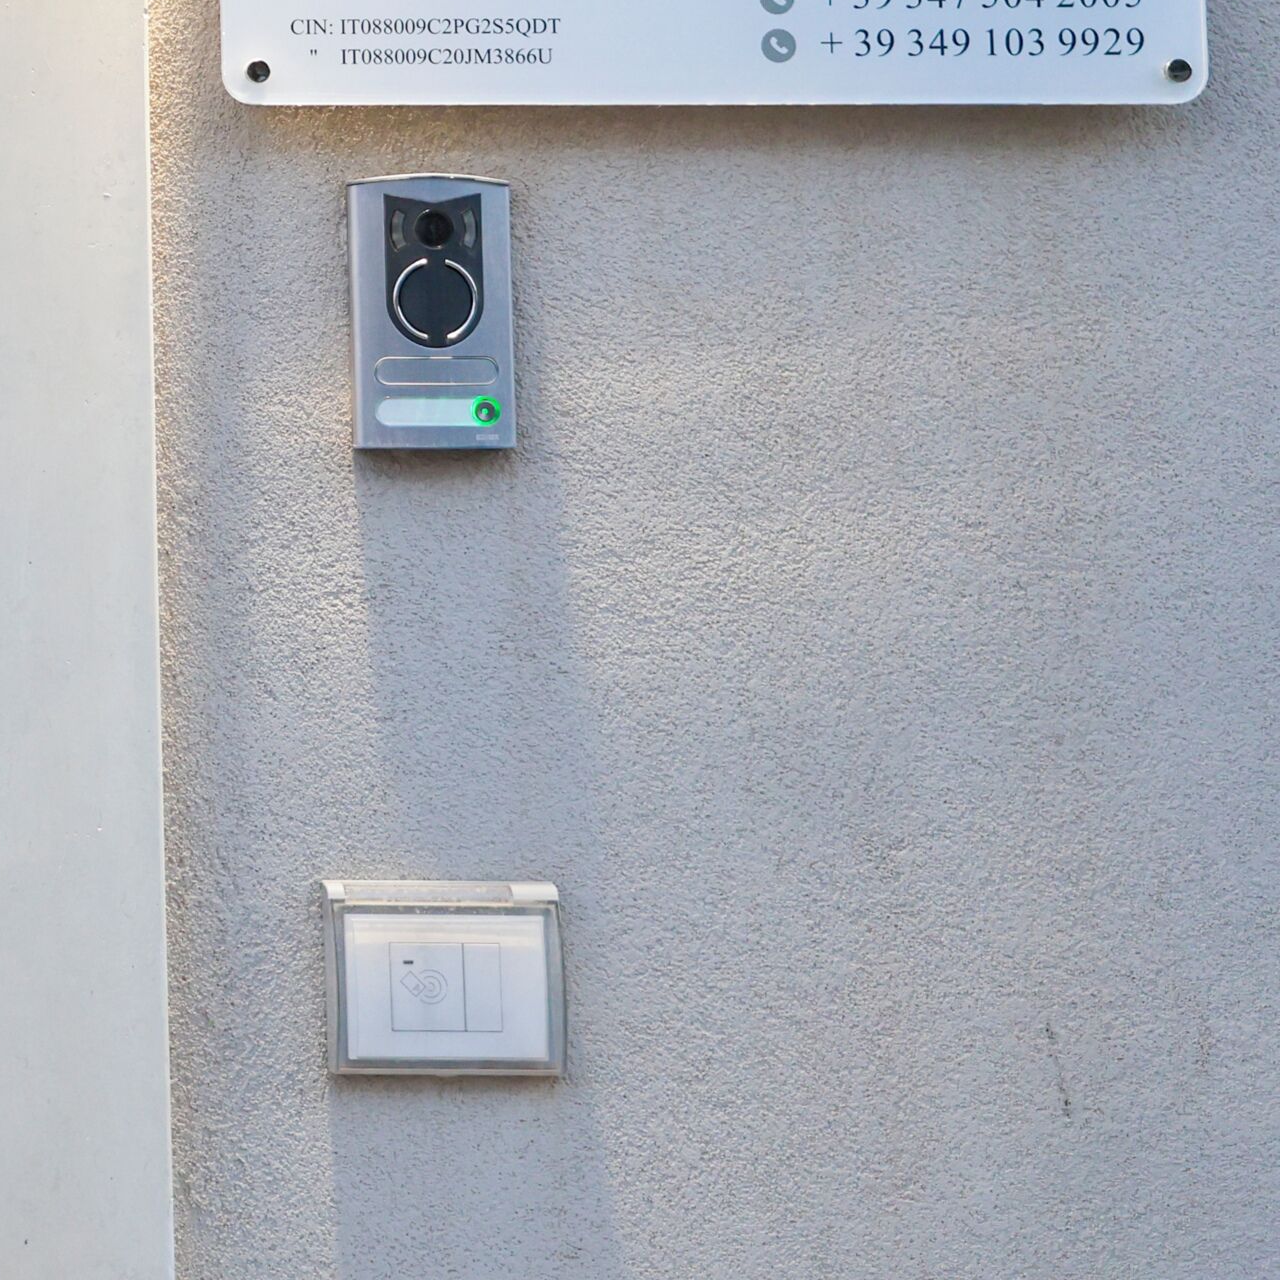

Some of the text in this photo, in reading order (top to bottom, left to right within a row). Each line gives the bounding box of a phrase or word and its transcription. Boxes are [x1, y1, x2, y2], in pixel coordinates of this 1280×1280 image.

[290, 17, 562, 39] CIN: IT088009C2PG2S5QDT
[854, 28, 896, 58] 39
[907, 27, 971, 57] 349
[985, 27, 1045, 57] 103
[1057, 26, 1145, 57] 9929
[341, 47, 553, 65] IT088009C20JM3866U
